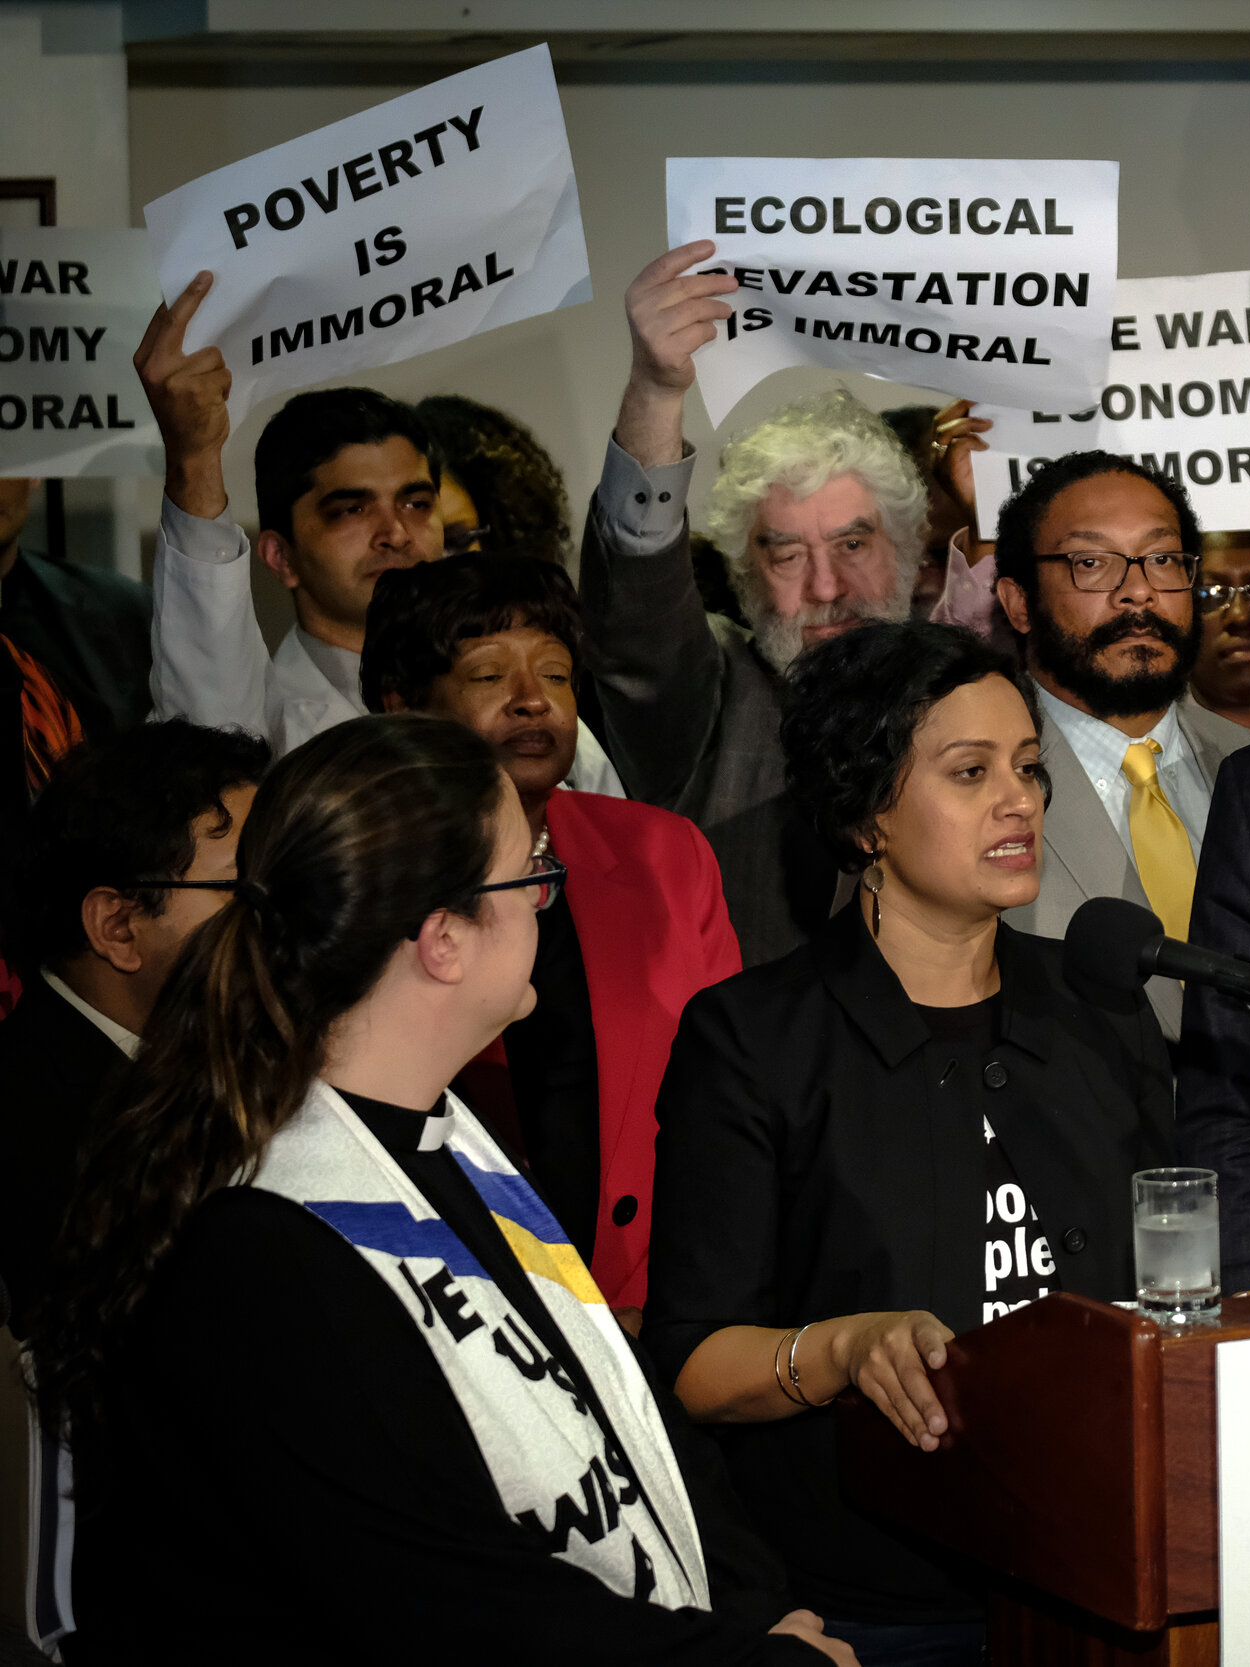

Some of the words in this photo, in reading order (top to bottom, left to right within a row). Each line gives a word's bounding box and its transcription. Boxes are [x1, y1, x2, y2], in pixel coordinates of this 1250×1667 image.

[224, 105, 484, 250] POVERTY
[715, 195, 1074, 236] ECOLOGICAL
[354, 226, 407, 276] IS
[251, 251, 514, 366] IMMORAL
[726, 306, 775, 342] IS
[794, 316, 1052, 365] IMMORAL
